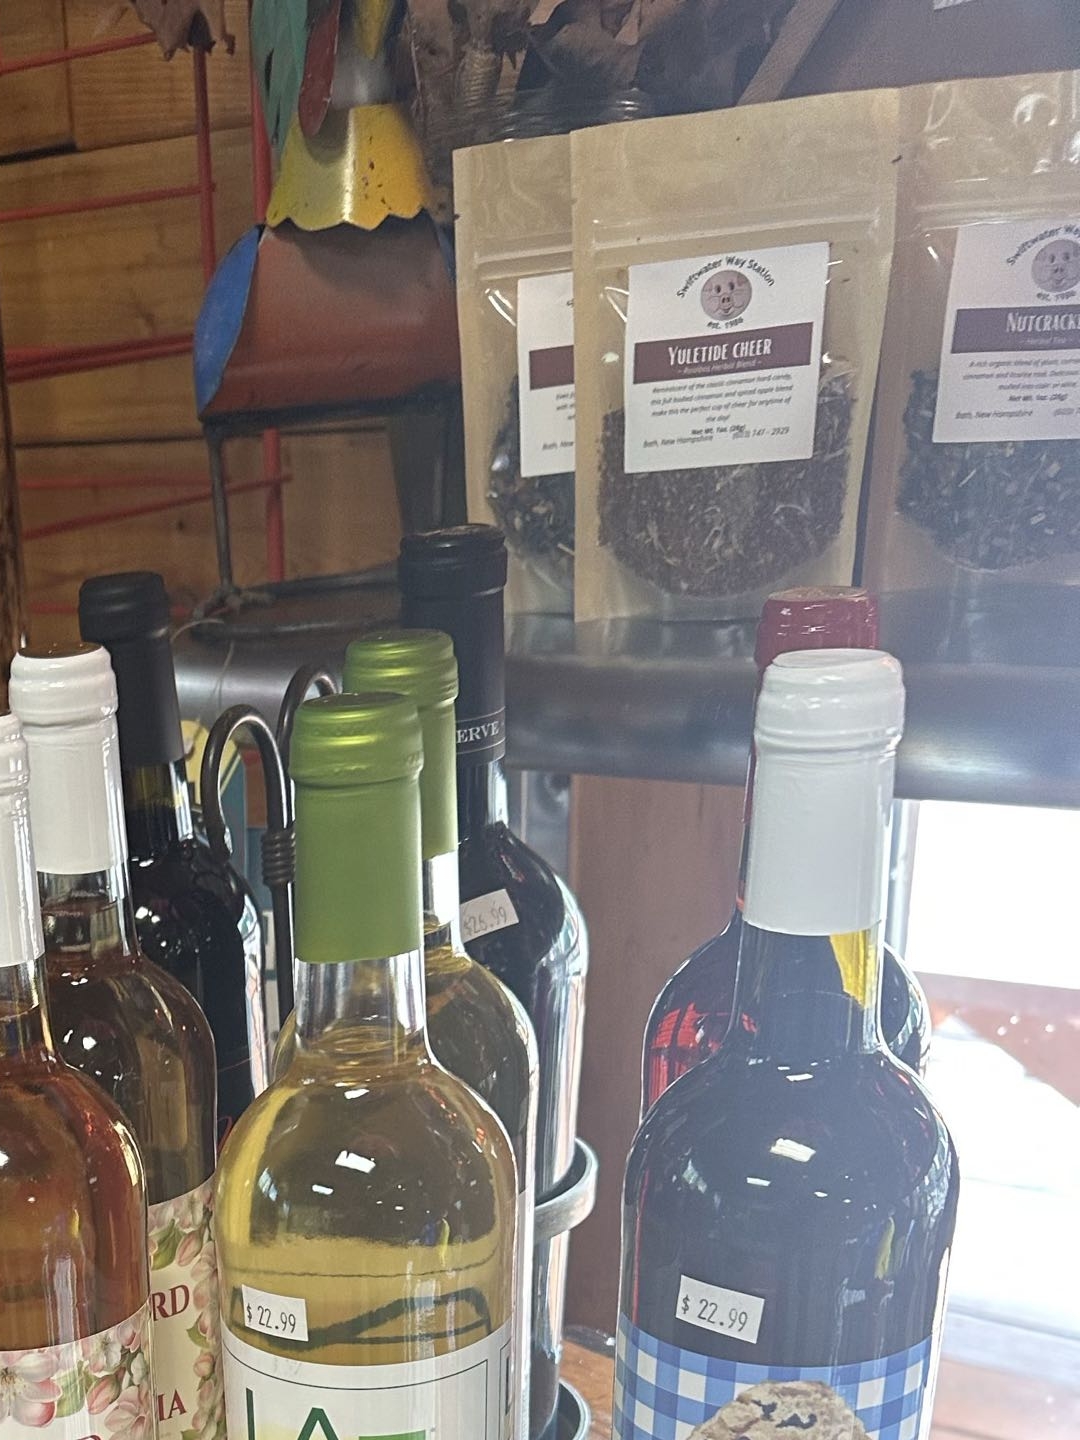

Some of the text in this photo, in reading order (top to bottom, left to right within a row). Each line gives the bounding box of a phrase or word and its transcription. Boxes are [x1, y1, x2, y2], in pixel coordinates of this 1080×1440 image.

[725, 255, 746, 269] Way
[747, 259, 775, 287] Station
[1006, 311, 1080, 333] NUTCRACKE
[668, 338, 773, 366] YULETIDE CHEER
[457, 721, 499, 743] ERVE
